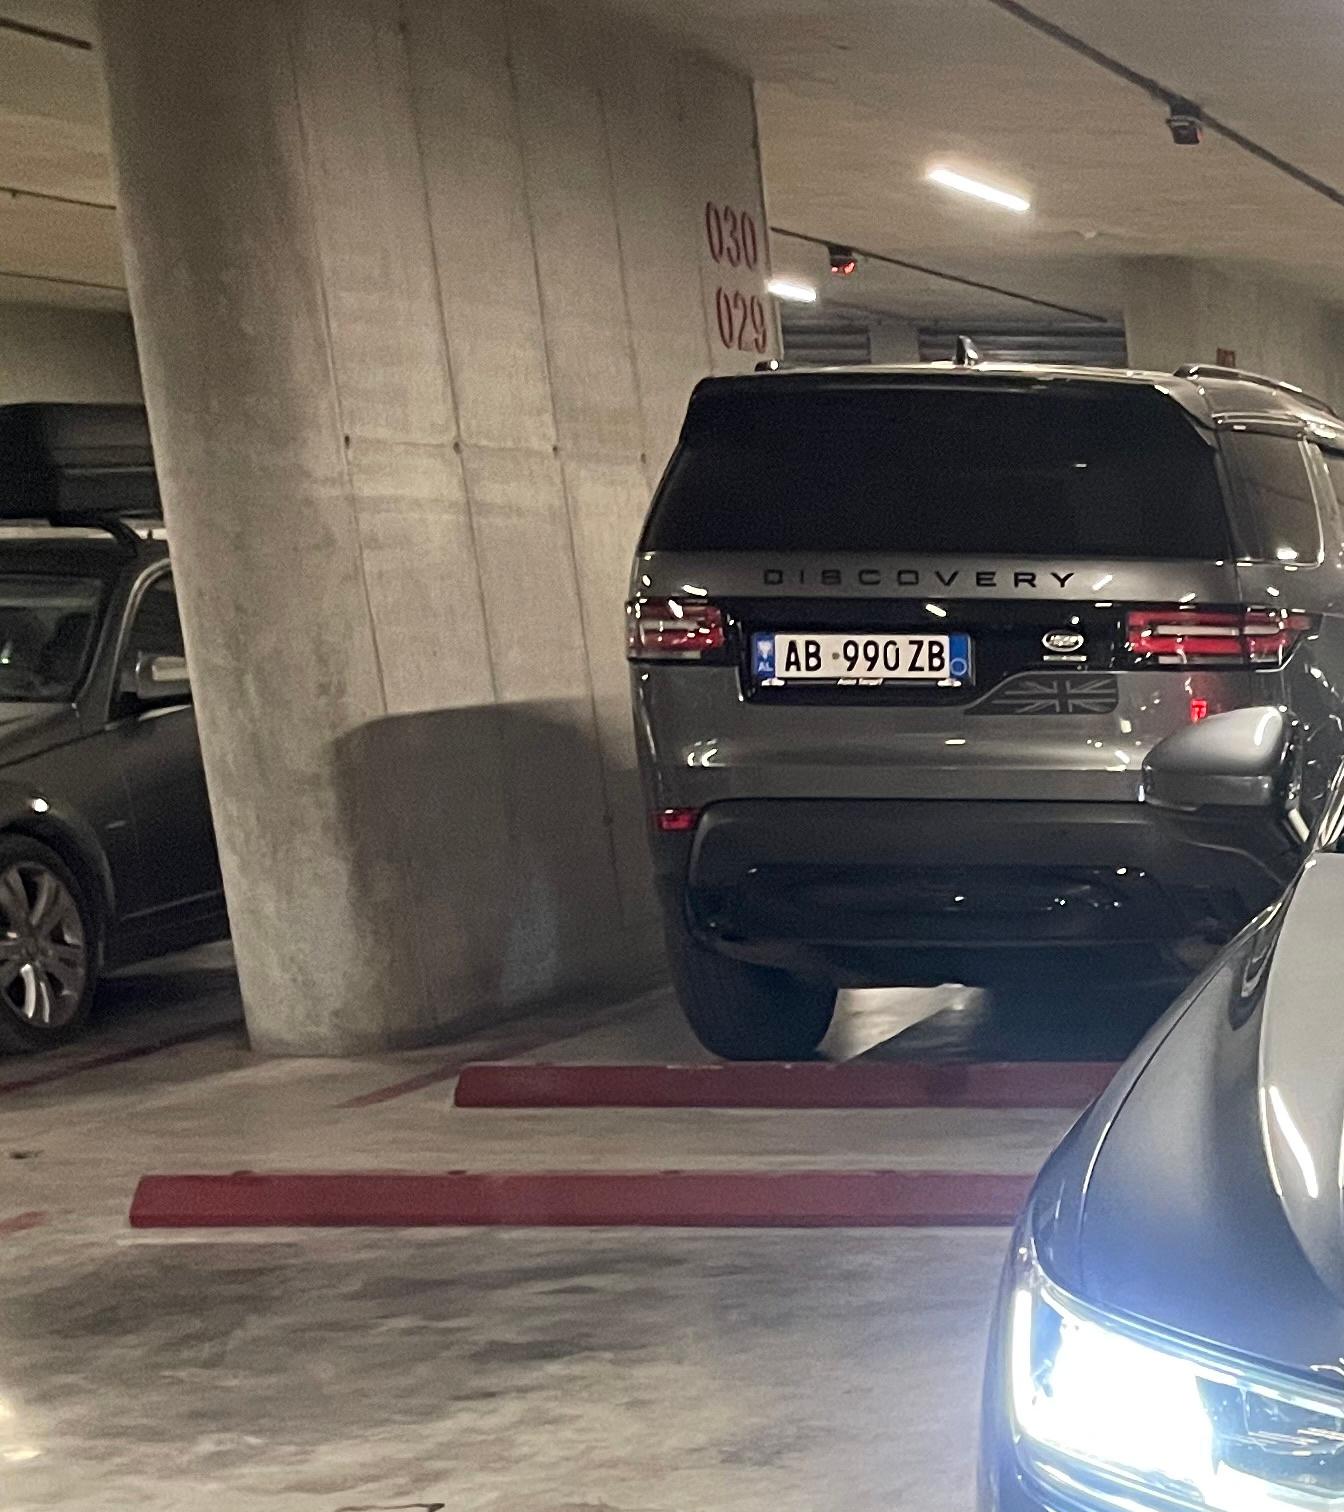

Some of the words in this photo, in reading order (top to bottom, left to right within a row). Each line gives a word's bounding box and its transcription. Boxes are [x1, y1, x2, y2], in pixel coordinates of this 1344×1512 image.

[705, 201, 758, 272] 030
[715, 286, 768, 353] 029
[763, 569, 1075, 588] DISCOVERY
[784, 639, 822, 673] AB
[842, 639, 900, 673] 990
[908, 639, 946, 673] ZB
